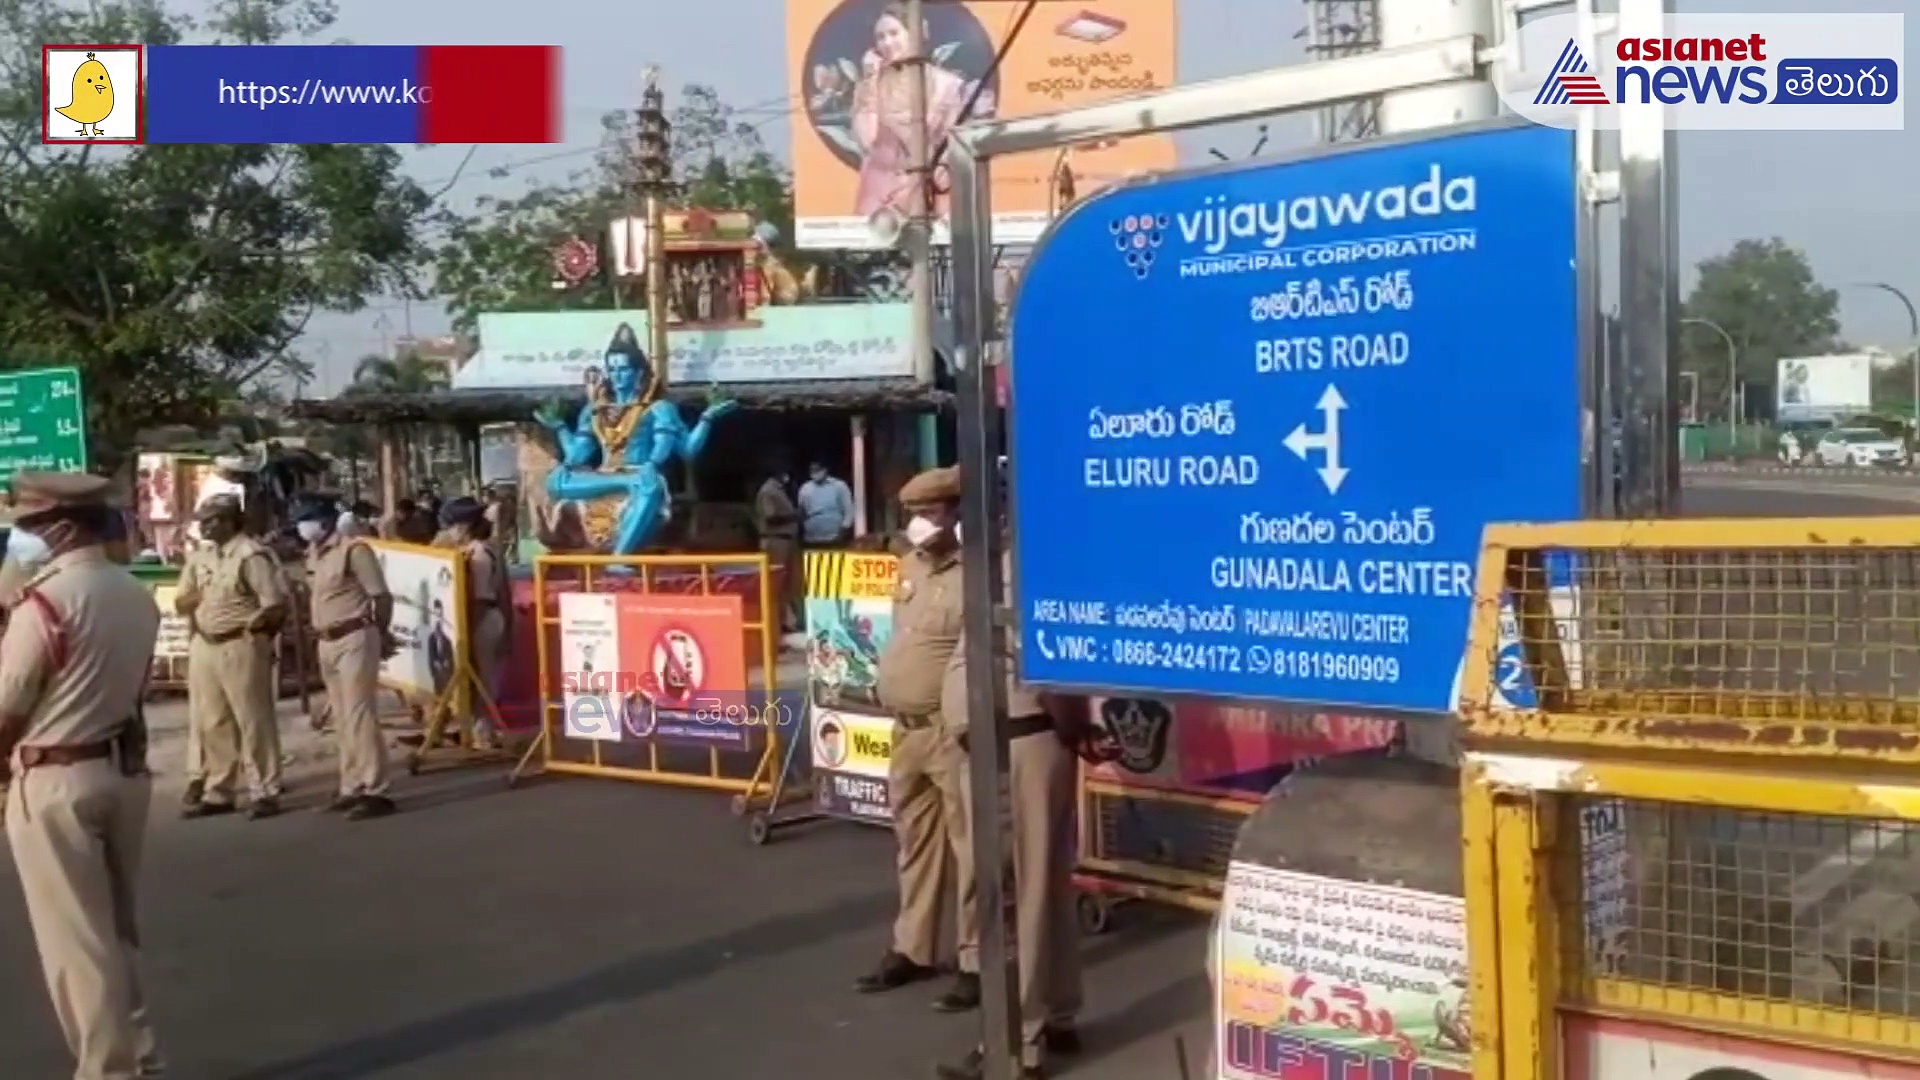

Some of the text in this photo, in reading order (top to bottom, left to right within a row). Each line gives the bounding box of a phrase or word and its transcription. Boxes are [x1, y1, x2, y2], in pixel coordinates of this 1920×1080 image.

[1177, 163, 1476, 253] vijayawada
[1180, 234, 1476, 278] MUNICIPAL CORPORATION
[1256, 331, 1409, 373] BRTS ROAD
[1180, 399, 1236, 435] రోడ్
[1085, 455, 1260, 487] ELURU ROAD
[1240, 506, 1434, 545] గుణదల సెంటర్
[852, 558, 898, 579] STOP
[1211, 556, 1472, 597] GUNADALA CENTER
[1033, 599, 1067, 623] AREA
[1351, 613, 1410, 644] CENTER
[1056, 635, 1097, 662] VMC
[1274, 648, 1400, 683] 8181960909
